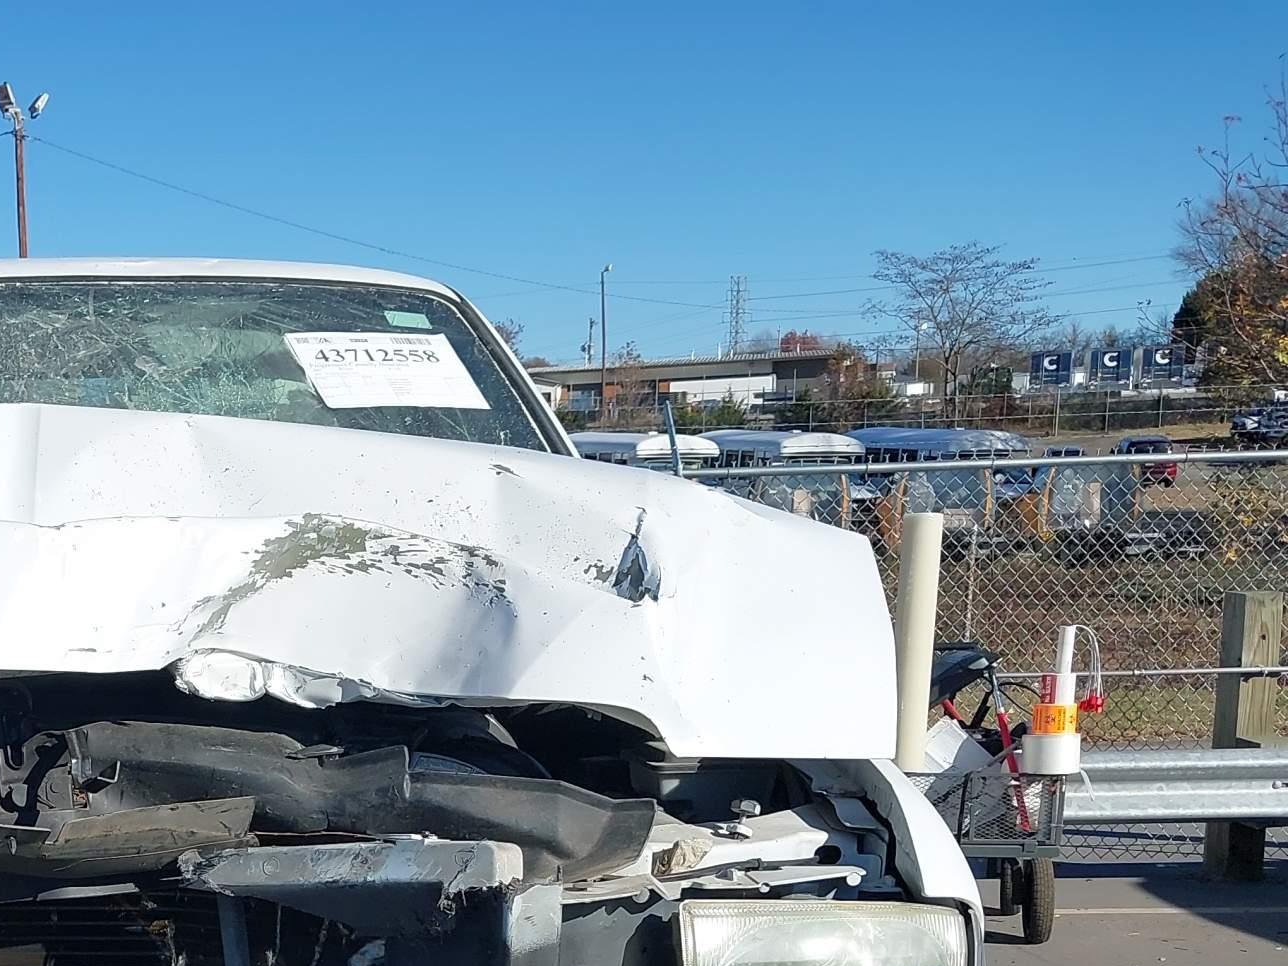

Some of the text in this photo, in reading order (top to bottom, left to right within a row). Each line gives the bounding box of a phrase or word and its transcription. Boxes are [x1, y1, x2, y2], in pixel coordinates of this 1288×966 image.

[314, 348, 440, 363] 43712558
[1043, 355, 1058, 370] C
[1103, 352, 1119, 367] C
[1155, 349, 1171, 365] C
